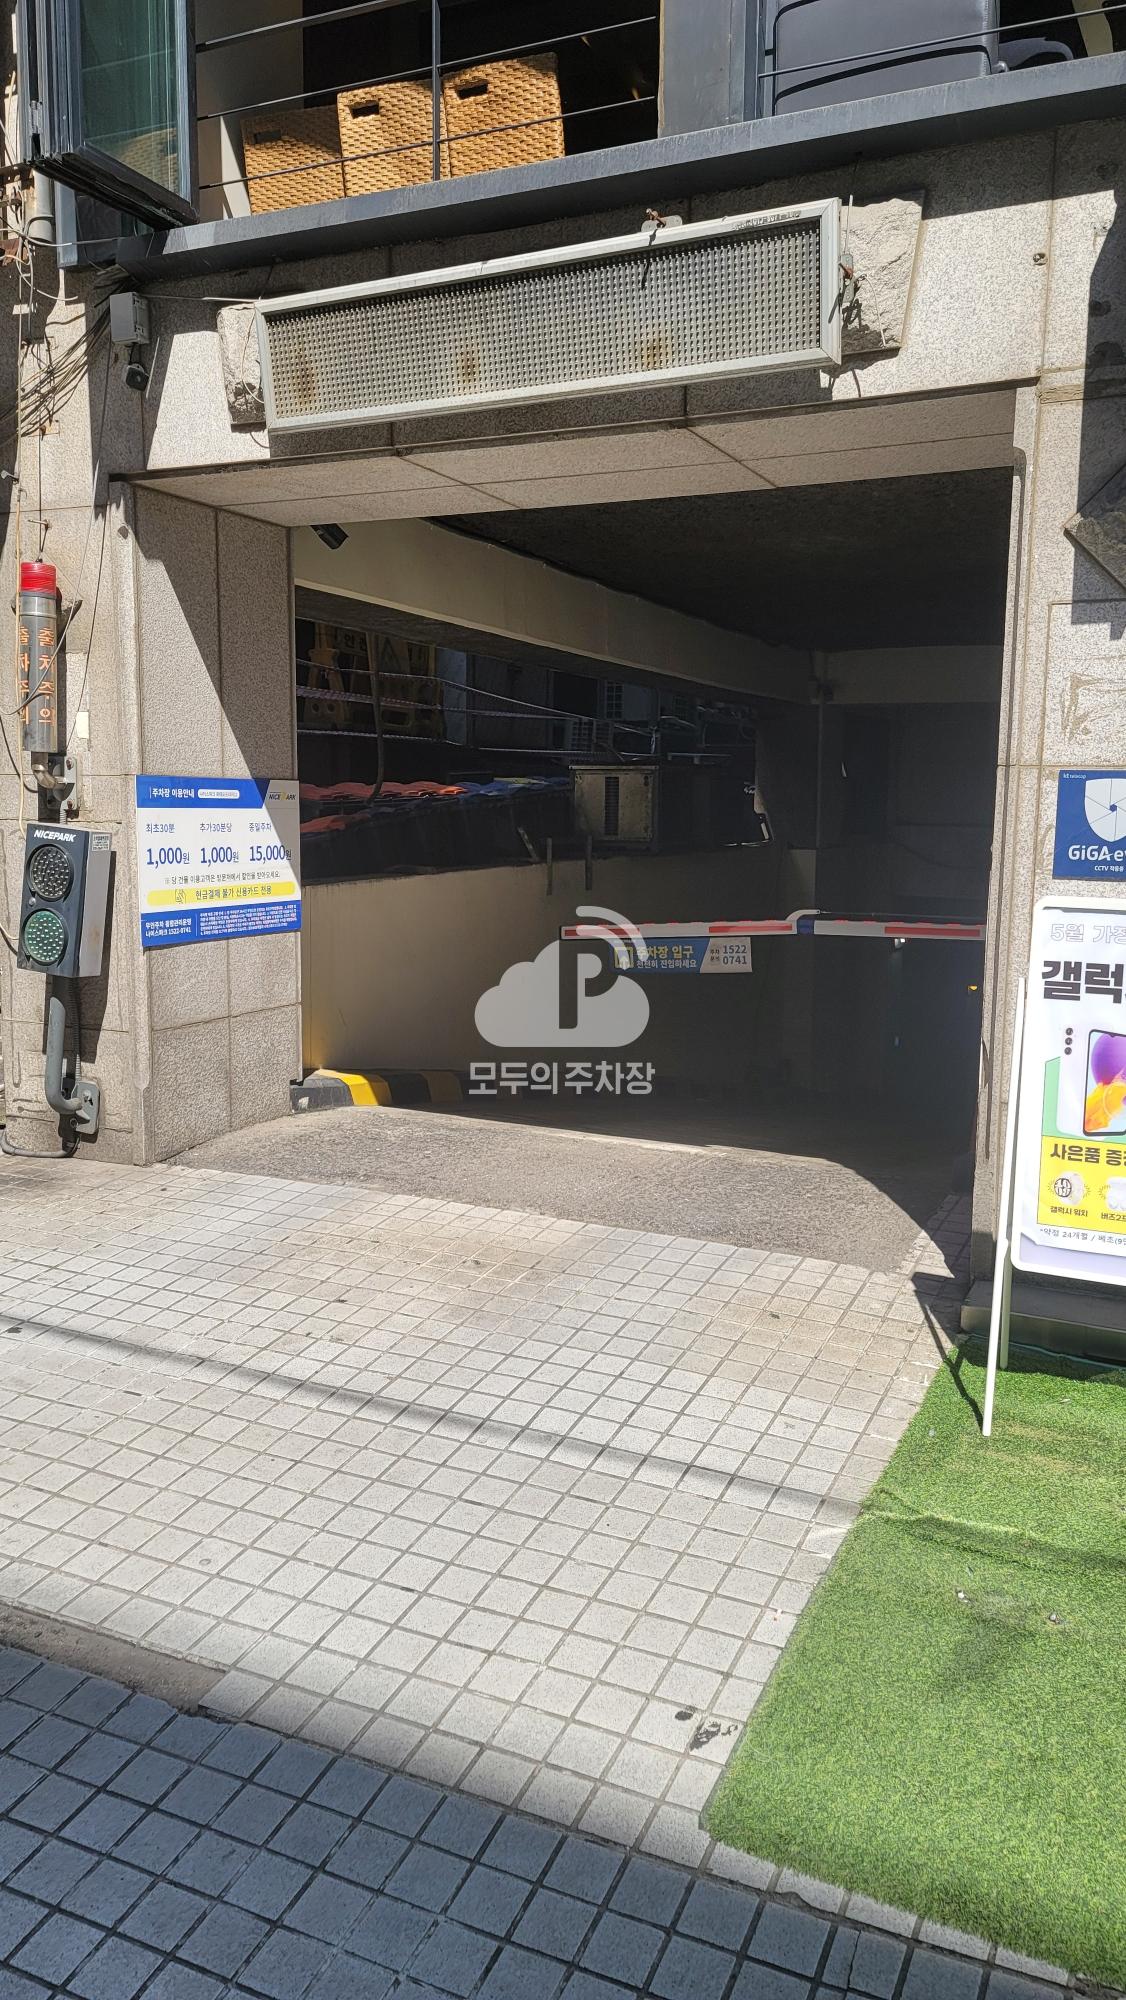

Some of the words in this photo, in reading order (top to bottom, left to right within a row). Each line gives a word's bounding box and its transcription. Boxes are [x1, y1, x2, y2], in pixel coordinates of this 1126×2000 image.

[152, 788, 170, 798] 주차장
[171, 788, 195, 799] 이용안내
[145, 823, 175, 834] 최초30분
[199, 822, 232, 833] 추가30분당
[248, 822, 272, 833] 종일주차
[34, 829, 76, 842] NICEPARK
[146, 847, 190, 869] 1,000원
[200, 846, 239, 867] 1,000원
[249, 845, 292, 864] 15,000원
[171, 875, 177, 885] 당
[178, 875, 189, 885] 건물
[222, 888, 234, 898] 불가
[236, 886, 259, 897] 신용카드
[260, 885, 272, 895] 전용
[1051, 923, 1085, 943] 5월
[671, 945, 694, 959] 입구
[723, 944, 747, 954] 1522
[636, 960, 658, 969] 천천히
[660, 959, 697, 969] 진입하세요
[722, 955, 747, 965] 0741
[1042, 960, 1126, 1004] 갤럭
[1050, 1143, 1101, 1164] 사은품
[1105, 1149, 1126, 1167] 증
[1050, 1205, 1072, 1215] 갤럭시
[1074, 1209, 1088, 1217] 워치
[1062, 1231, 1088, 1240] 24개월
